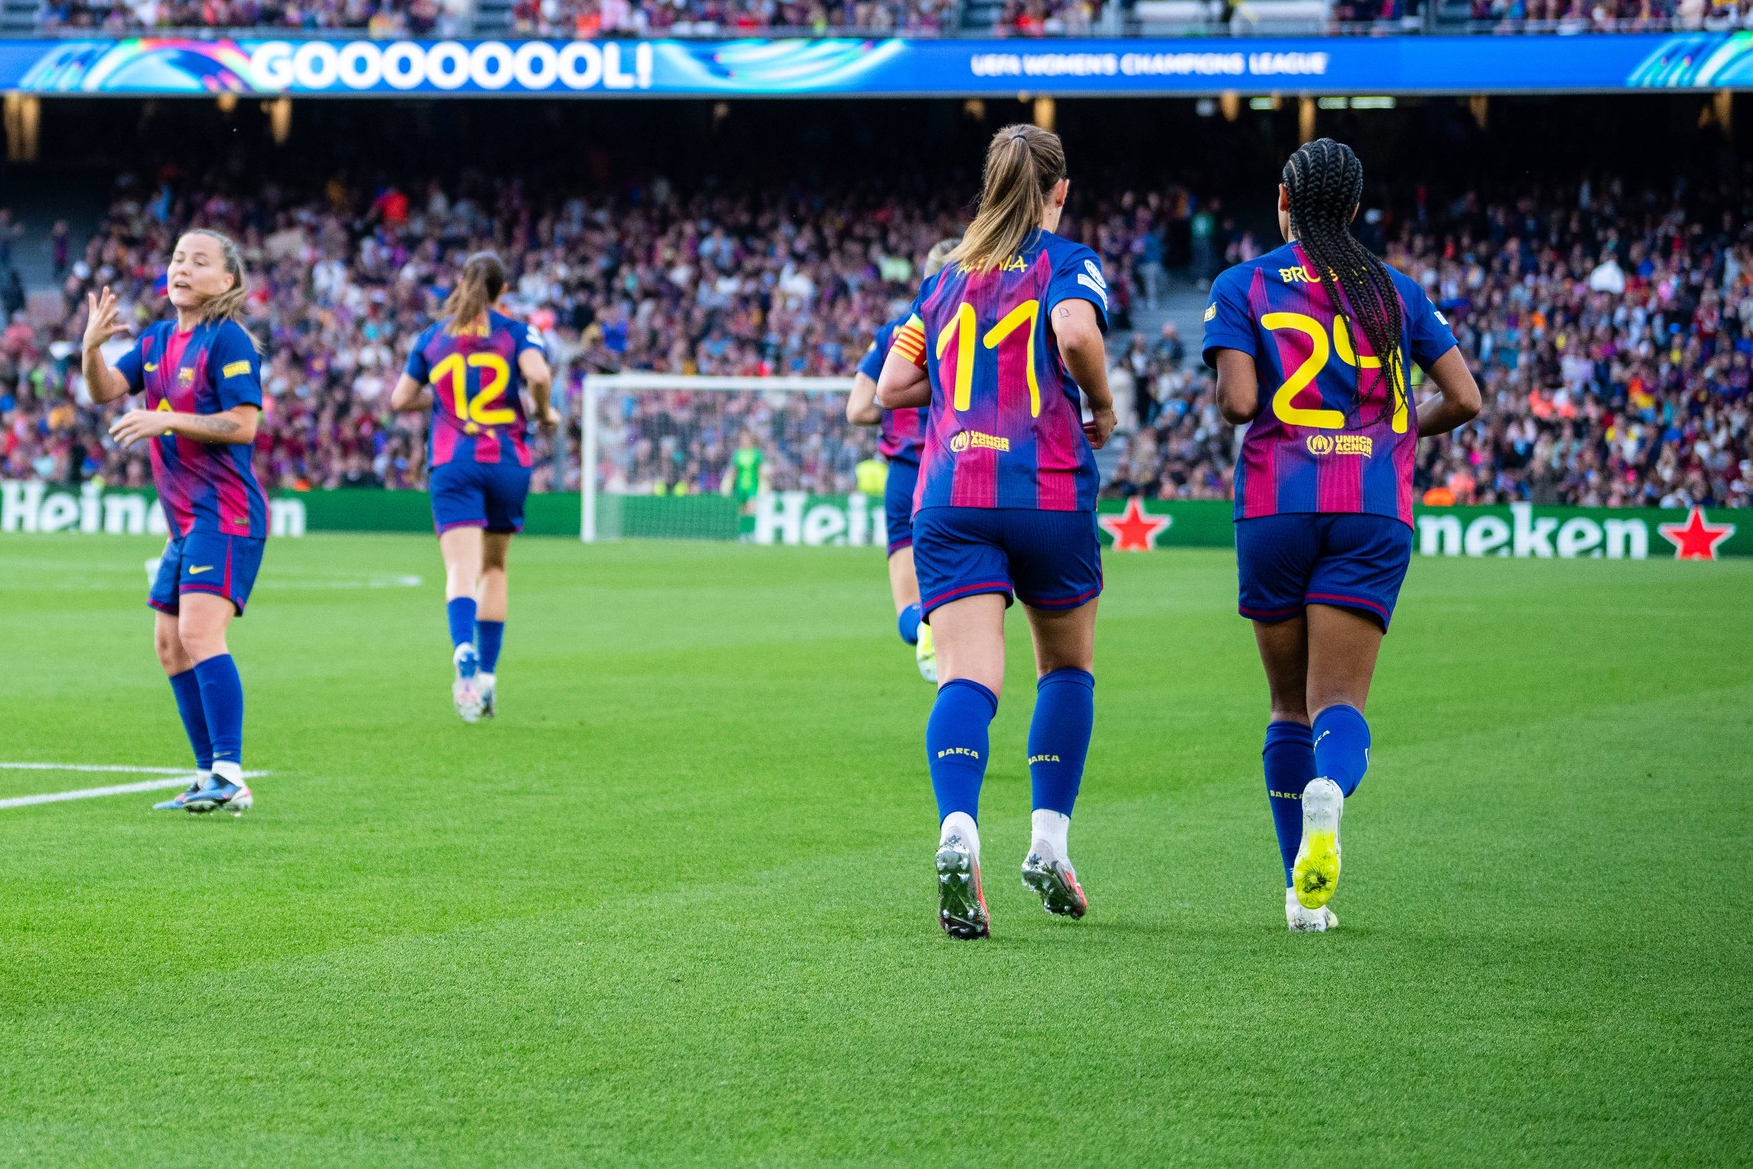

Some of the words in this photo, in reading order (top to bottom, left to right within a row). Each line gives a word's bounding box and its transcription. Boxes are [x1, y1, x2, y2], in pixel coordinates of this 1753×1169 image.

[250, 41, 653, 90] GOOOOOOOL!
[428, 352, 517, 425] 12
[936, 299, 1041, 419] 11
[1260, 312, 1408, 434] 24
[1335, 435, 1373, 447] UNHCR
[1335, 443, 1372, 456] ACNUR
[1417, 501, 1649, 560] neken
